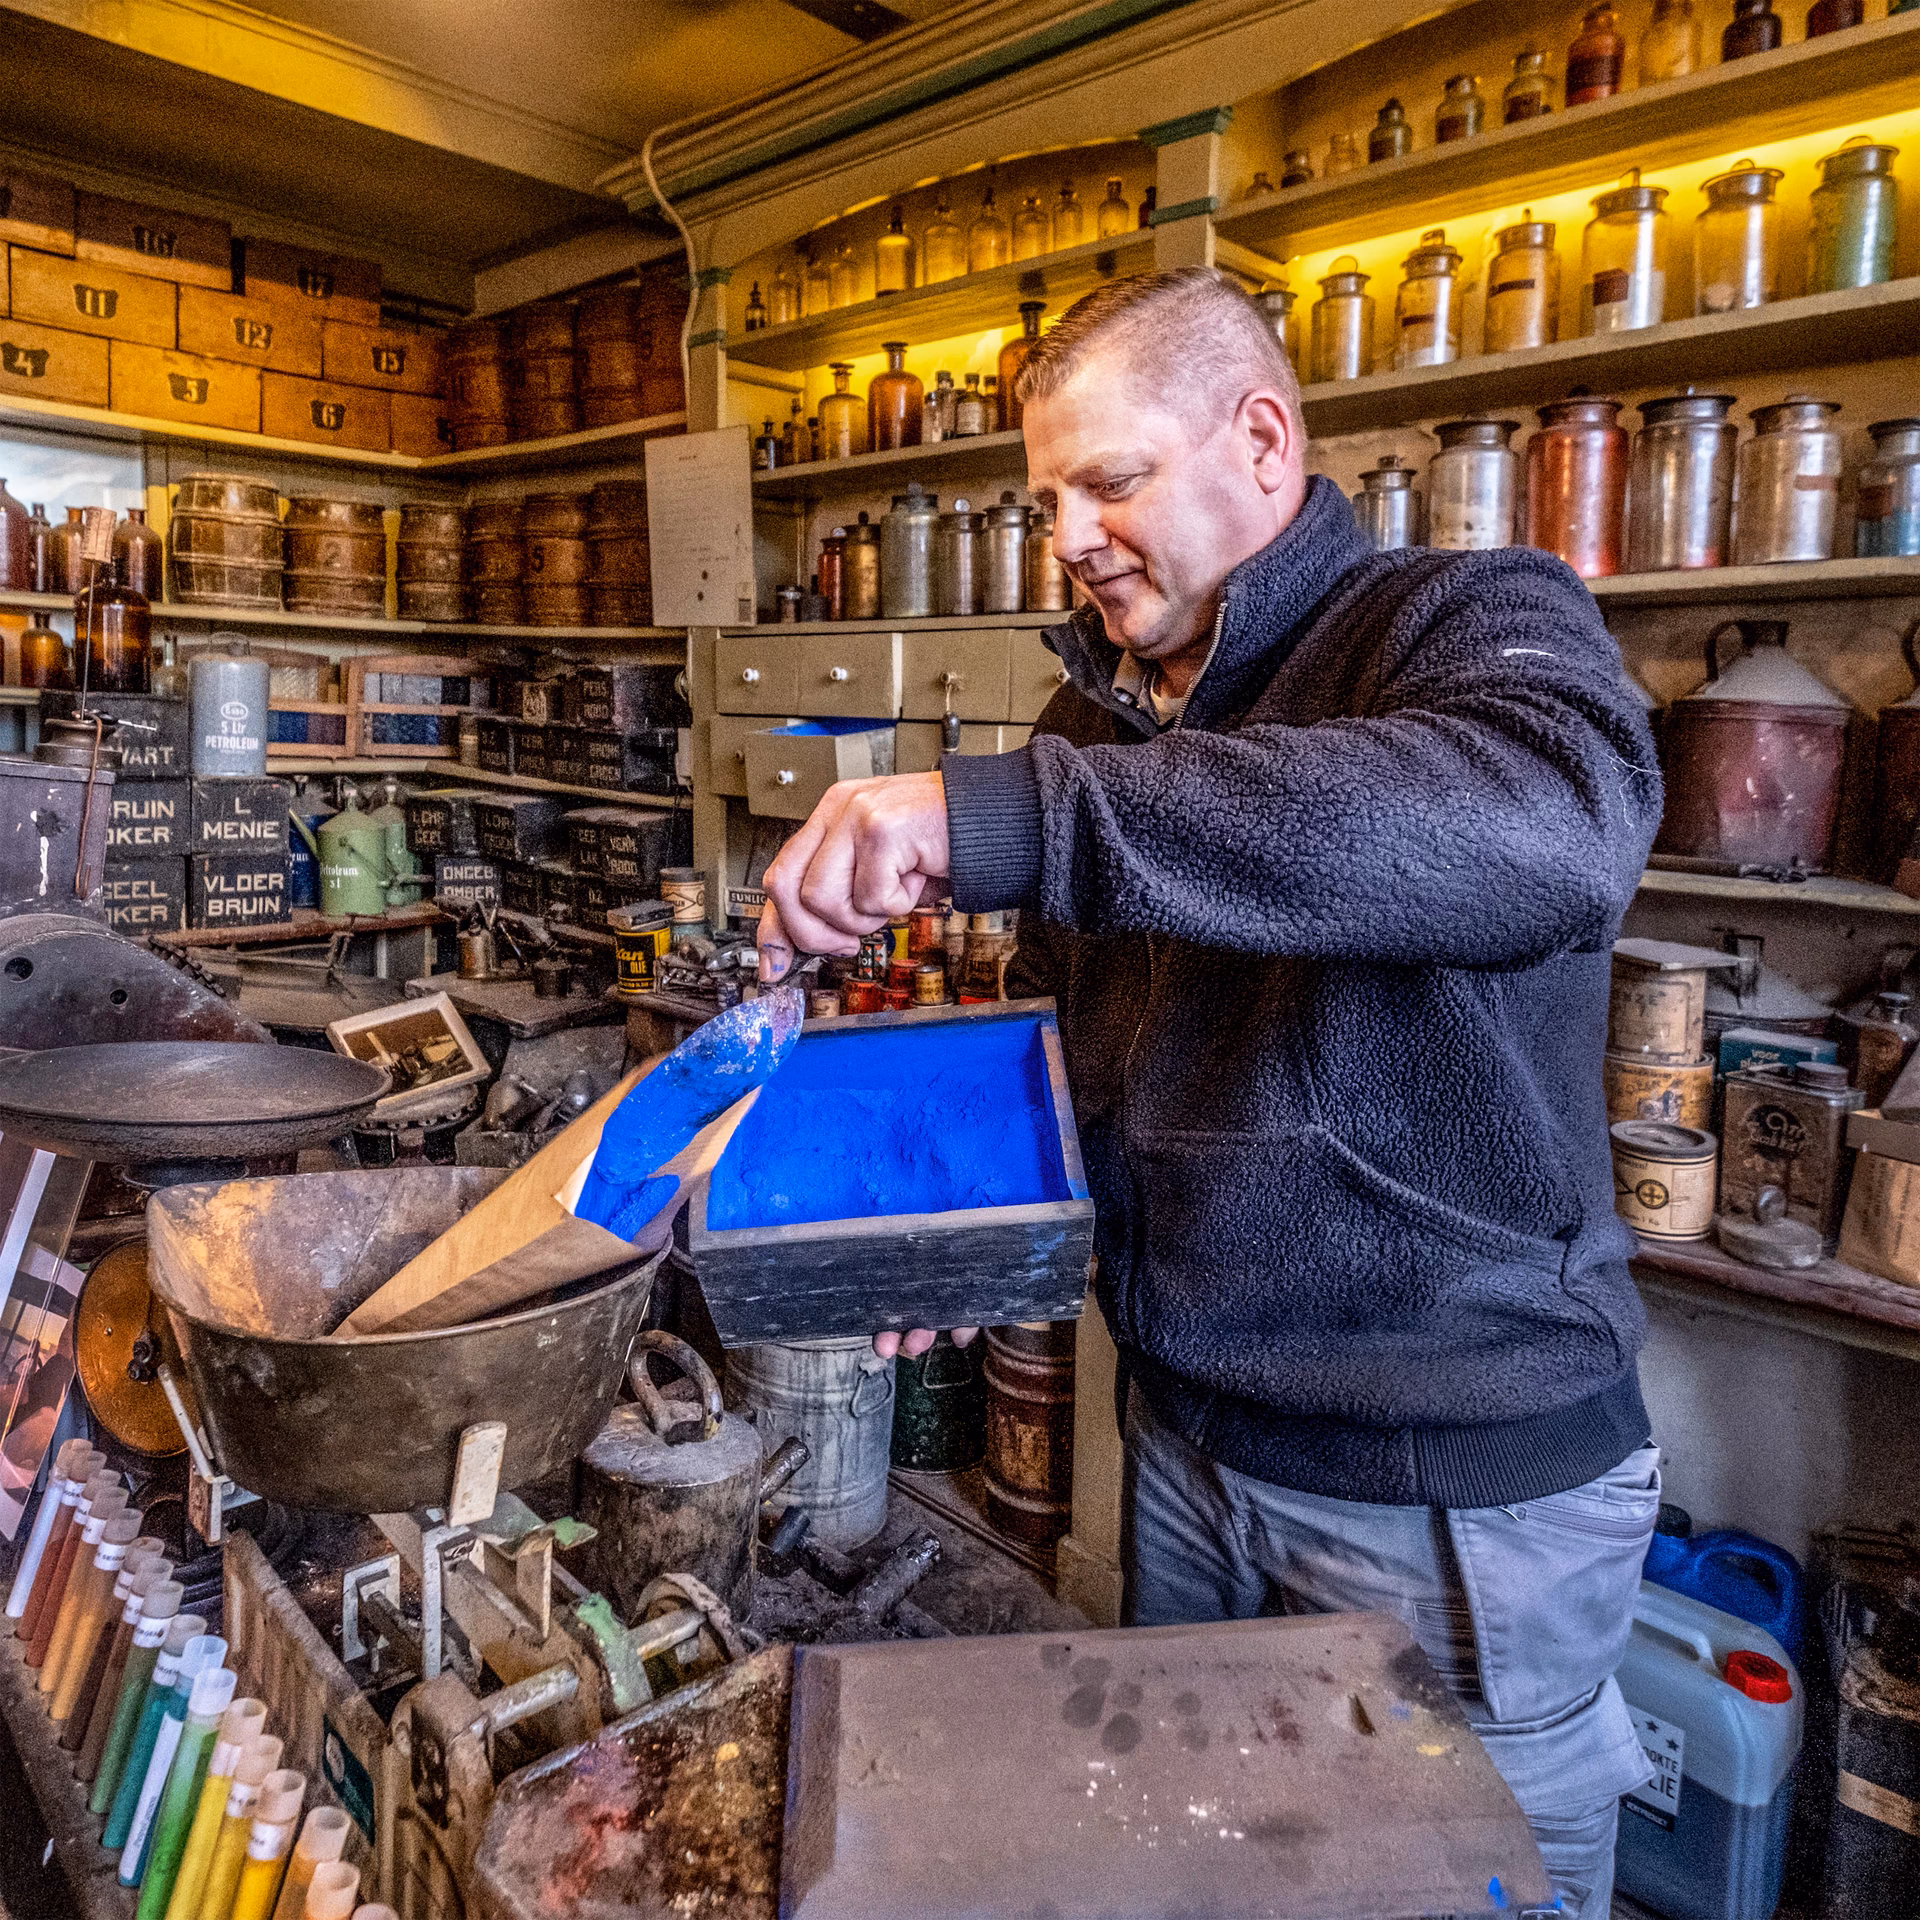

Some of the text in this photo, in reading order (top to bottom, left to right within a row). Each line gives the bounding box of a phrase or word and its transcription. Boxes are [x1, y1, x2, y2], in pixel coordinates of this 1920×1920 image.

[85, 290, 107, 317] 11
[243, 320, 268, 348] 12
[221, 721, 247, 735] 5 Ltr
[205, 735, 260, 750] PETROLEUM
[121, 746, 174, 765] ART
[113, 801, 175, 819] RUIN
[234, 797, 250, 814] L
[203, 821, 280, 840] MENIE
[204, 874, 284, 893] VLOER
[105, 905, 169, 924] KER
[208, 897, 281, 917] BRUIN
